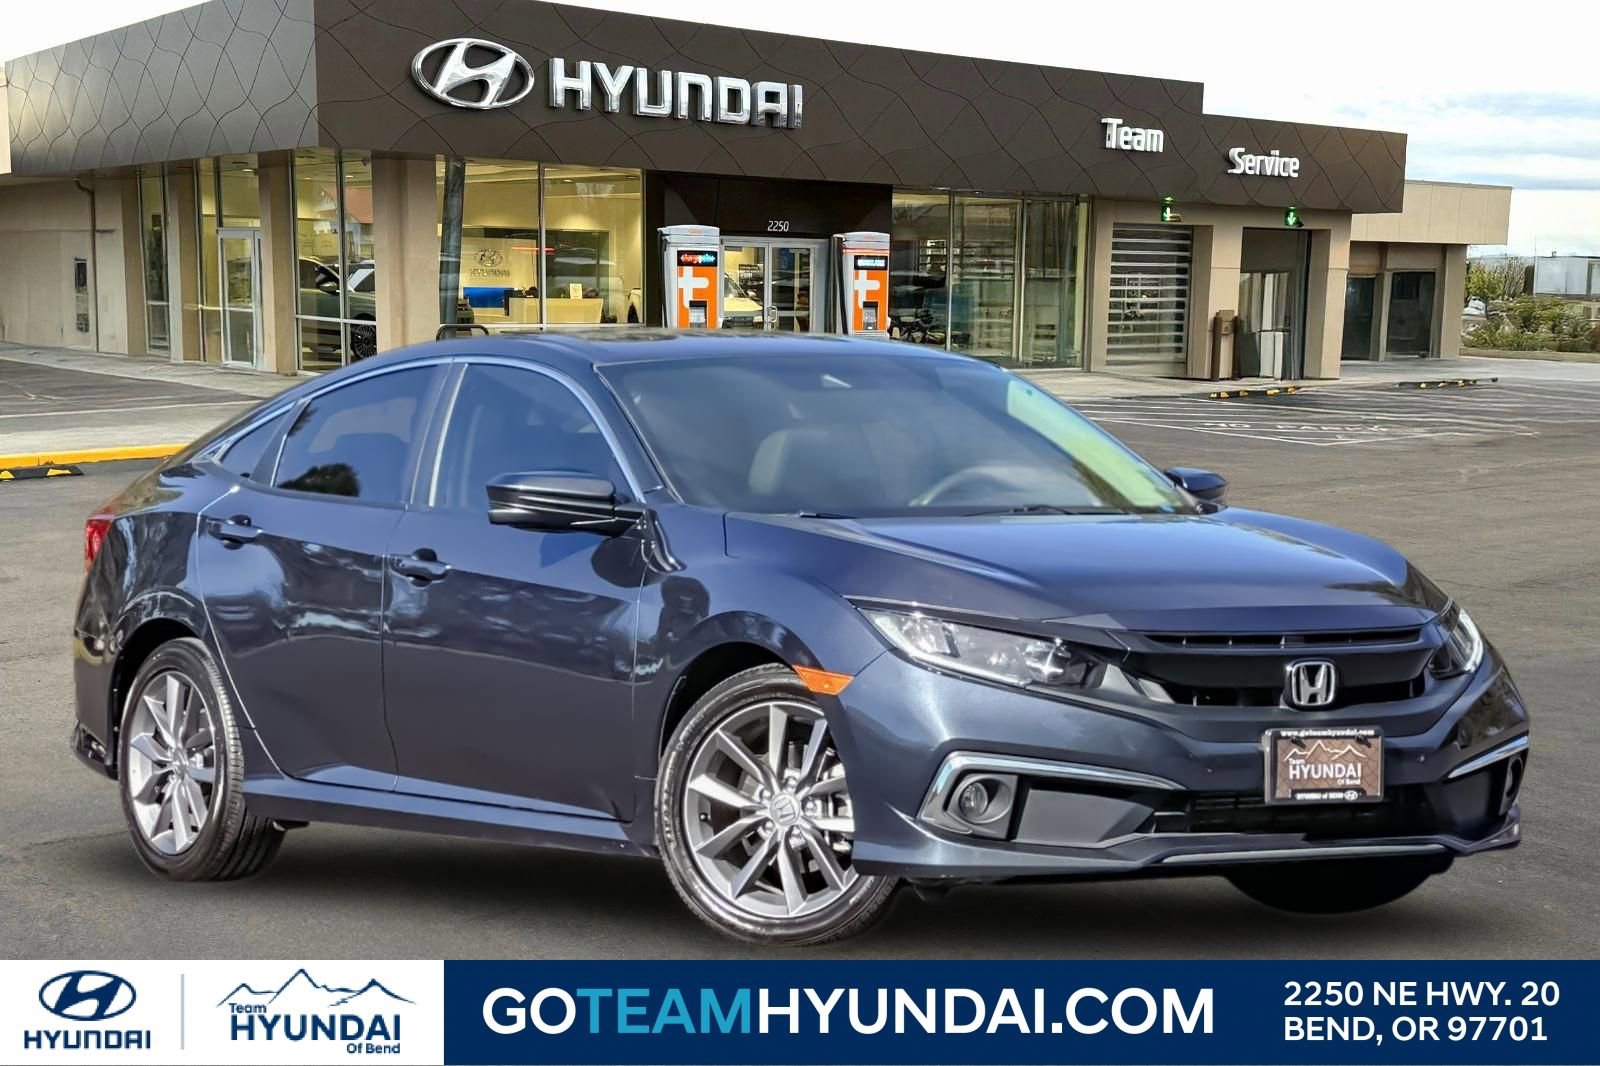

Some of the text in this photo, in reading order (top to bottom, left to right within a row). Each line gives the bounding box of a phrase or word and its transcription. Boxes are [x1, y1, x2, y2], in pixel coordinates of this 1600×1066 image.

[549, 57, 804, 128] HYUNDAI
[1101, 117, 1165, 153] Team
[1227, 146, 1301, 178] Service
[767, 220, 790, 232] 2250
[1288, 762, 1362, 780] HYUNDAI
